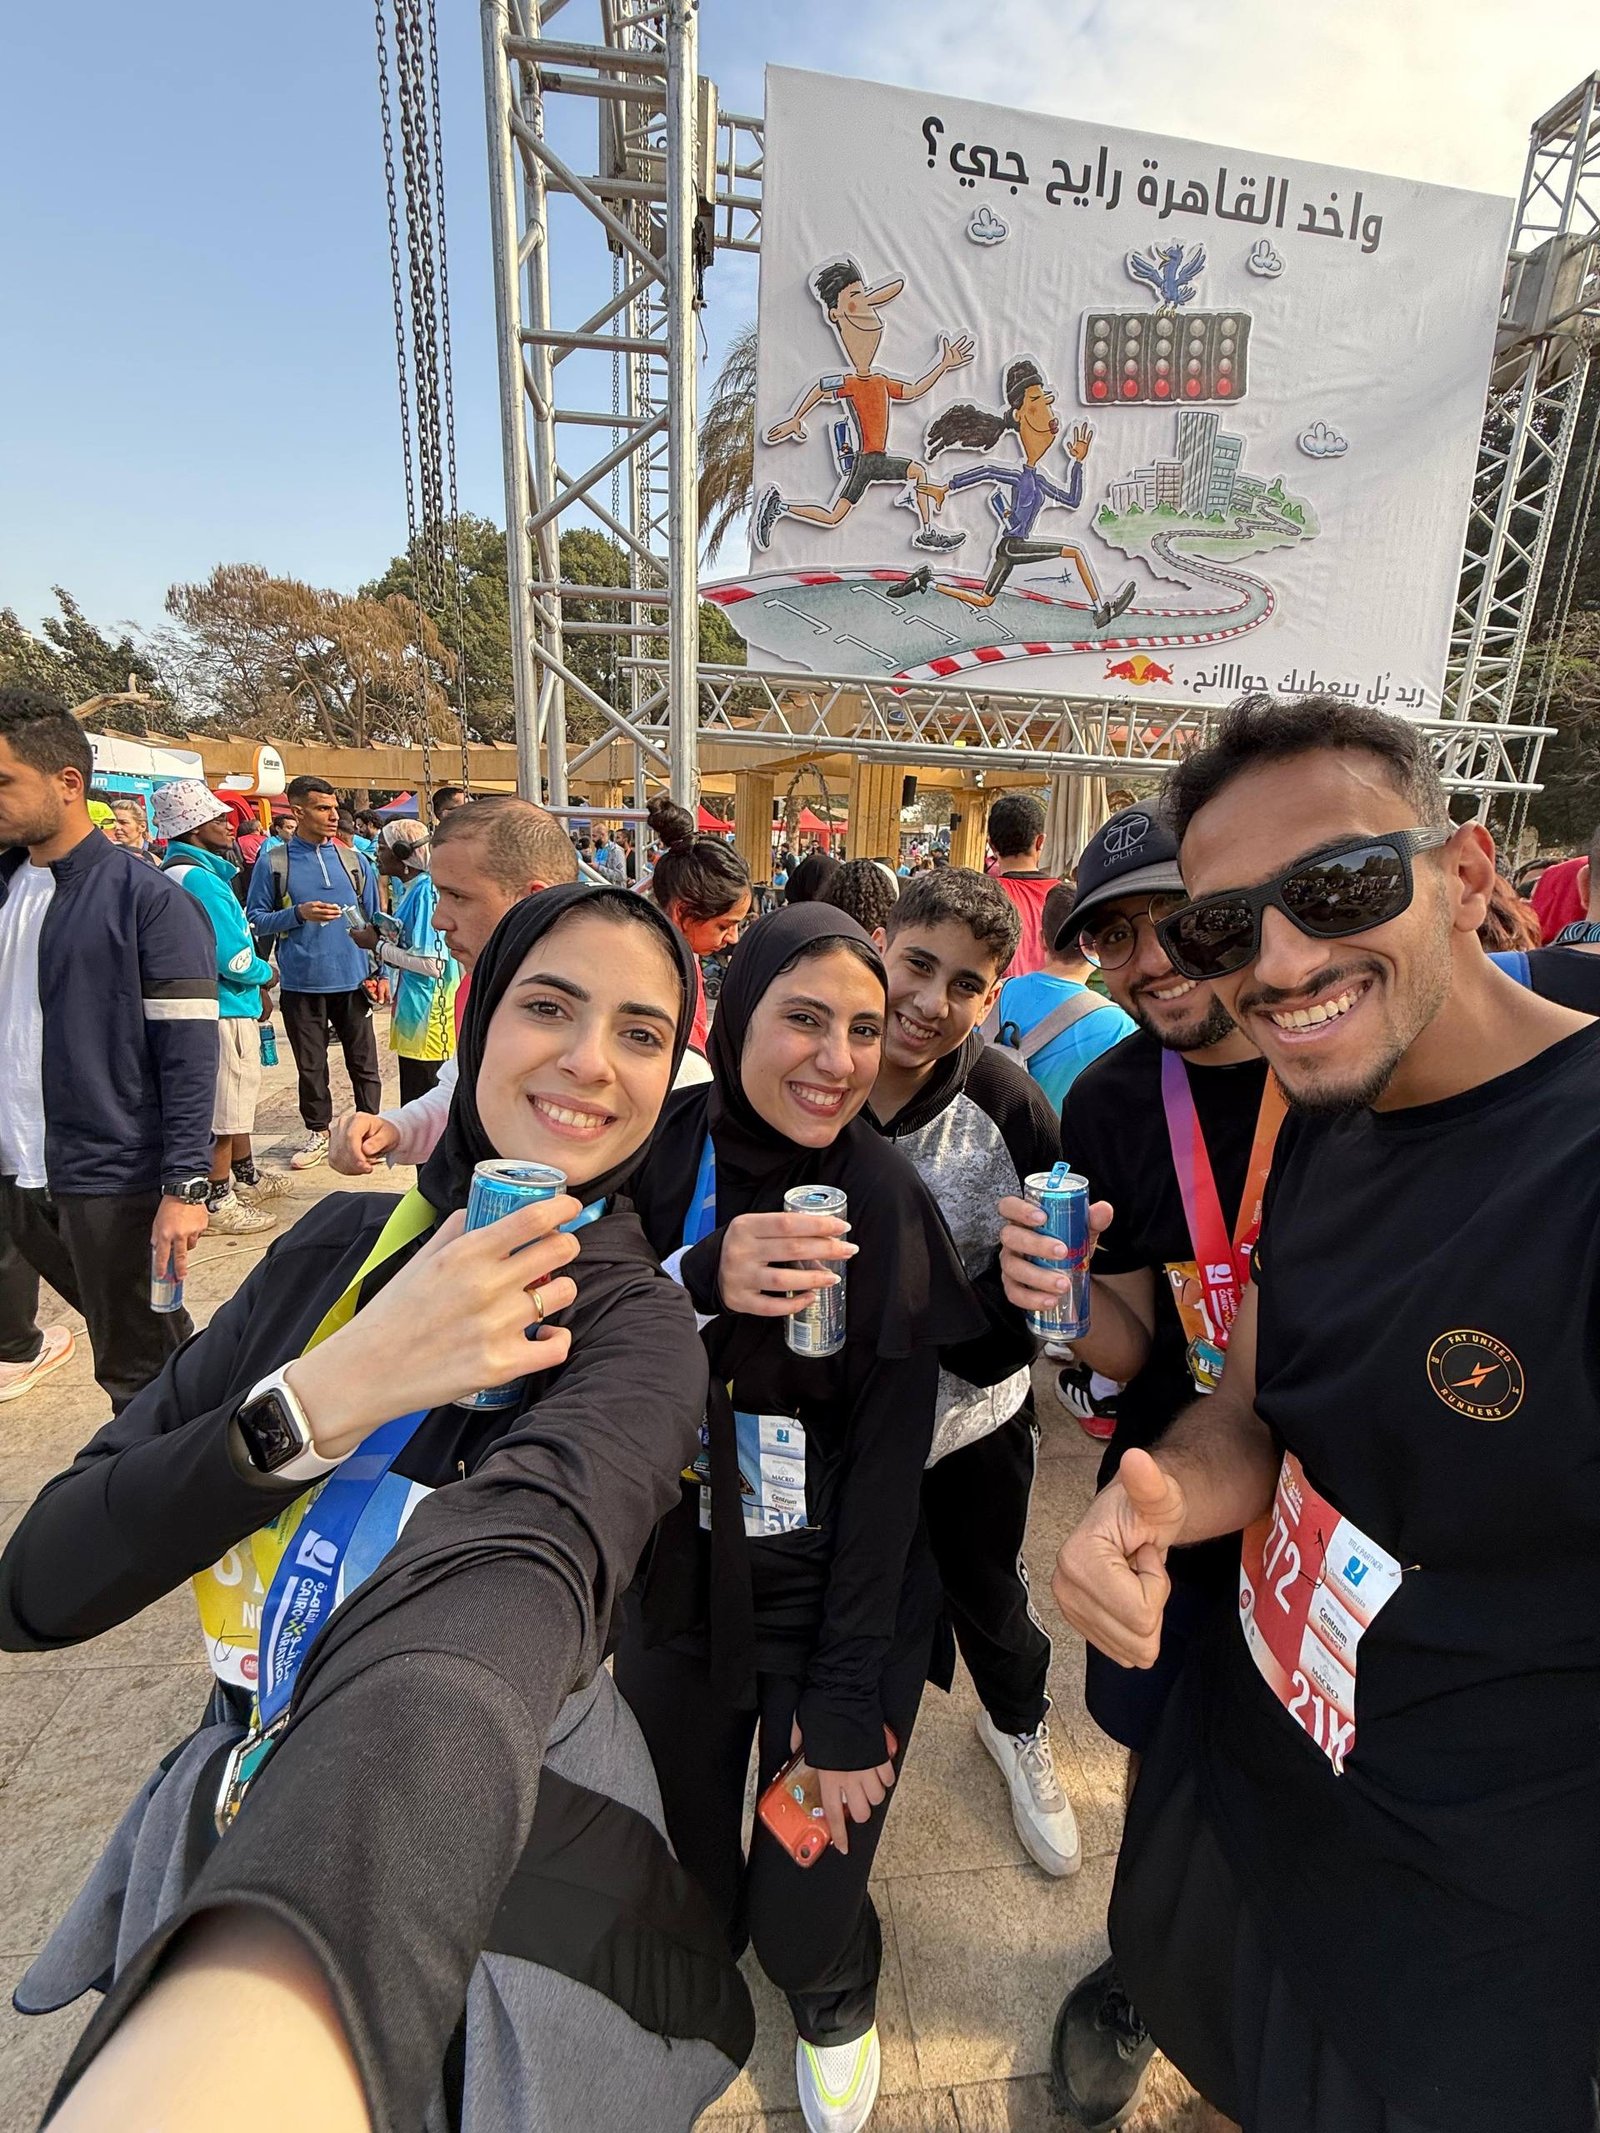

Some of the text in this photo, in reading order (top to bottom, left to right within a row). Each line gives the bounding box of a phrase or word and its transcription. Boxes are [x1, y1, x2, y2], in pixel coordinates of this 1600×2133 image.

[922, 116, 1384, 254] واخد القاهرة رايح جي؟
[1395, 687, 1425, 708] ريد
[1103, 843, 1145, 867] UPLIFT
[1448, 1334, 1511, 1362] FAT UNITED
[1441, 1388, 1501, 1416] RUNNERS
[764, 1510, 802, 1533] 5K
[291, 1577, 315, 1621] CAIRO
[308, 1581, 328, 1624] القاهرة
[1328, 1567, 1366, 1608] Developments
[1320, 1607, 1348, 1645] Centrum
[1320, 1624, 1343, 1652] ENERGY
[1312, 1666, 1339, 1699] MACRO
[1288, 1669, 1356, 1774] 21K
